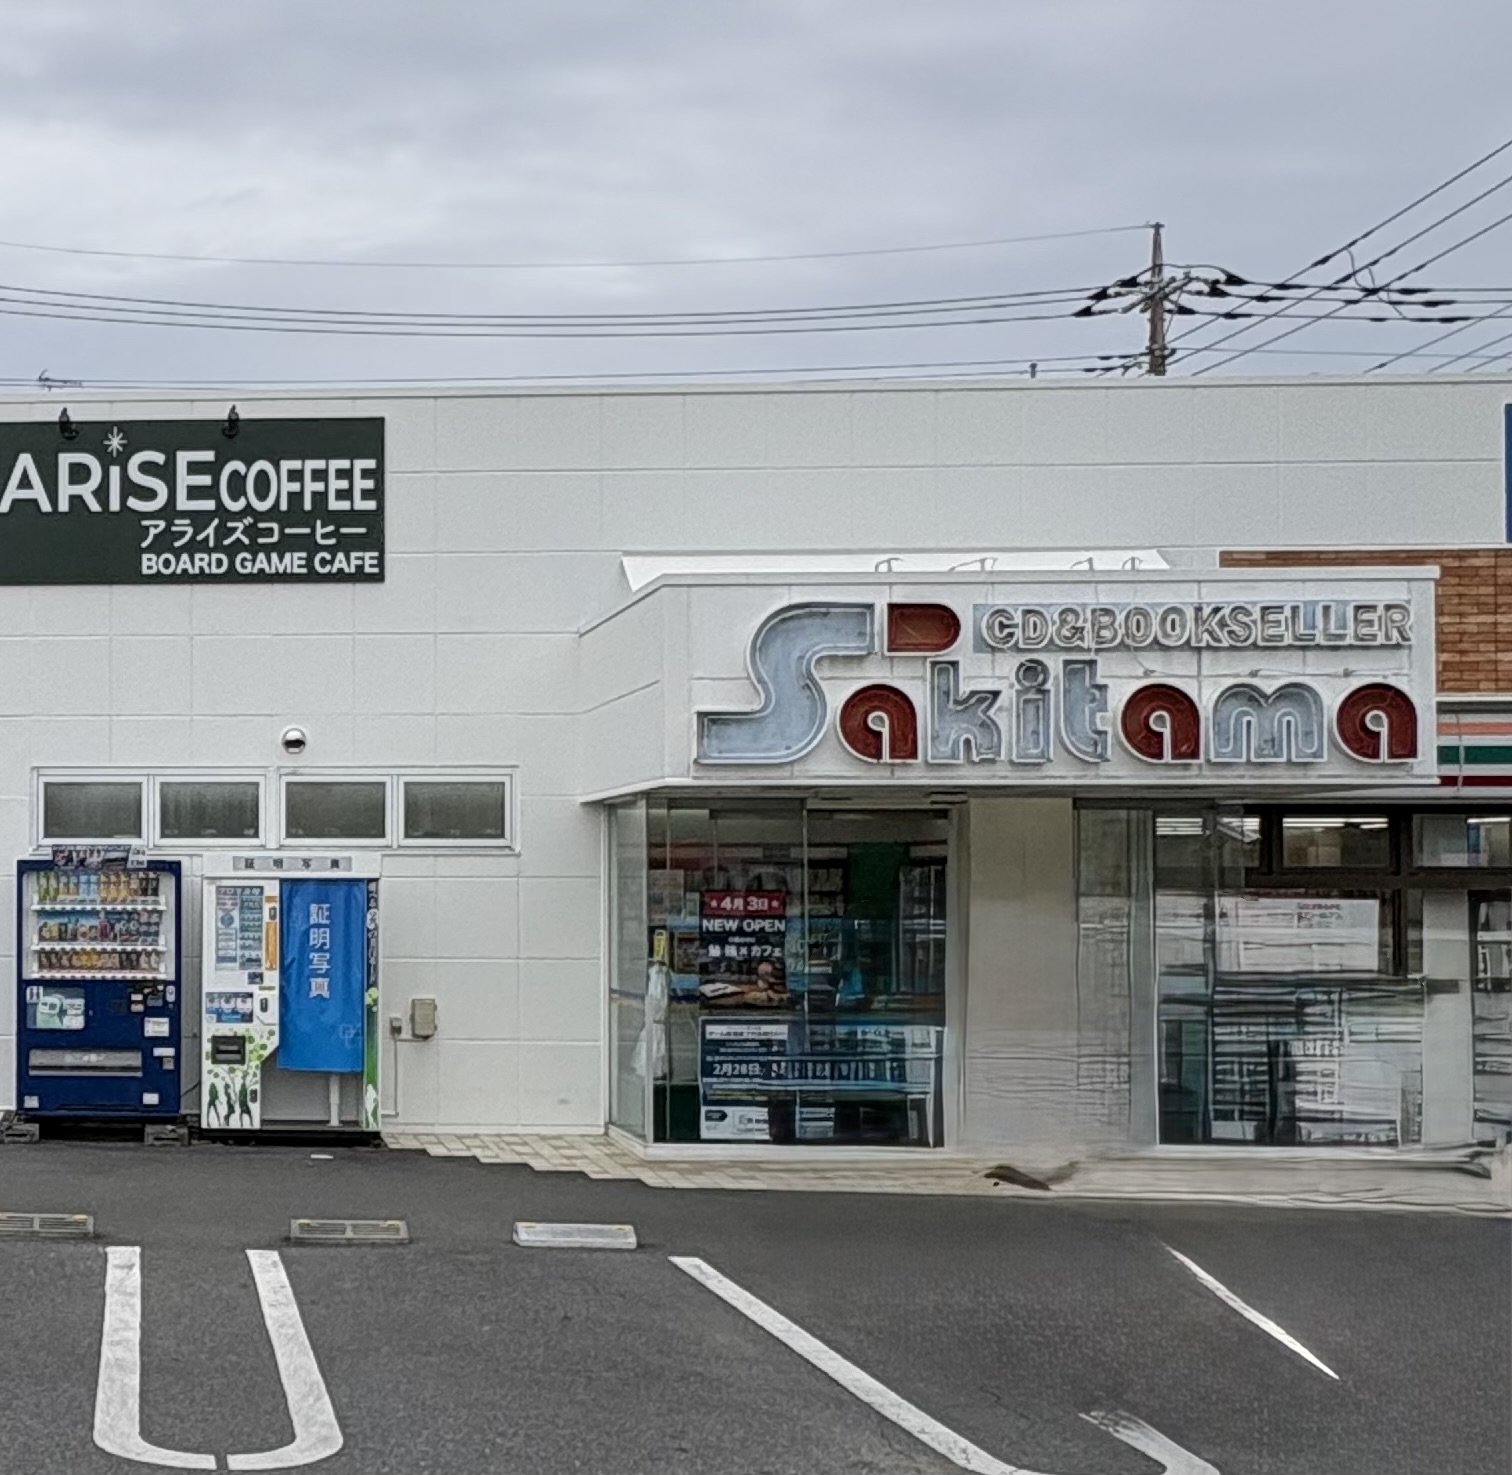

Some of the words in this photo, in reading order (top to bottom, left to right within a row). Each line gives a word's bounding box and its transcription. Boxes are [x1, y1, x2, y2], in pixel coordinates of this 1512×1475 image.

[219, 458, 377, 512] COFFEE
[139, 516, 367, 548] アライズコーヒー
[141, 552, 229, 575] BOARD
[235, 552, 307, 574] GAME
[314, 551, 379, 574] CAFE
[980, 602, 1414, 648] CD&BOOKSELLER
[702, 918, 740, 932] NEW
[743, 918, 786, 932] OPEN
[308, 903, 332, 999] 証明写真
